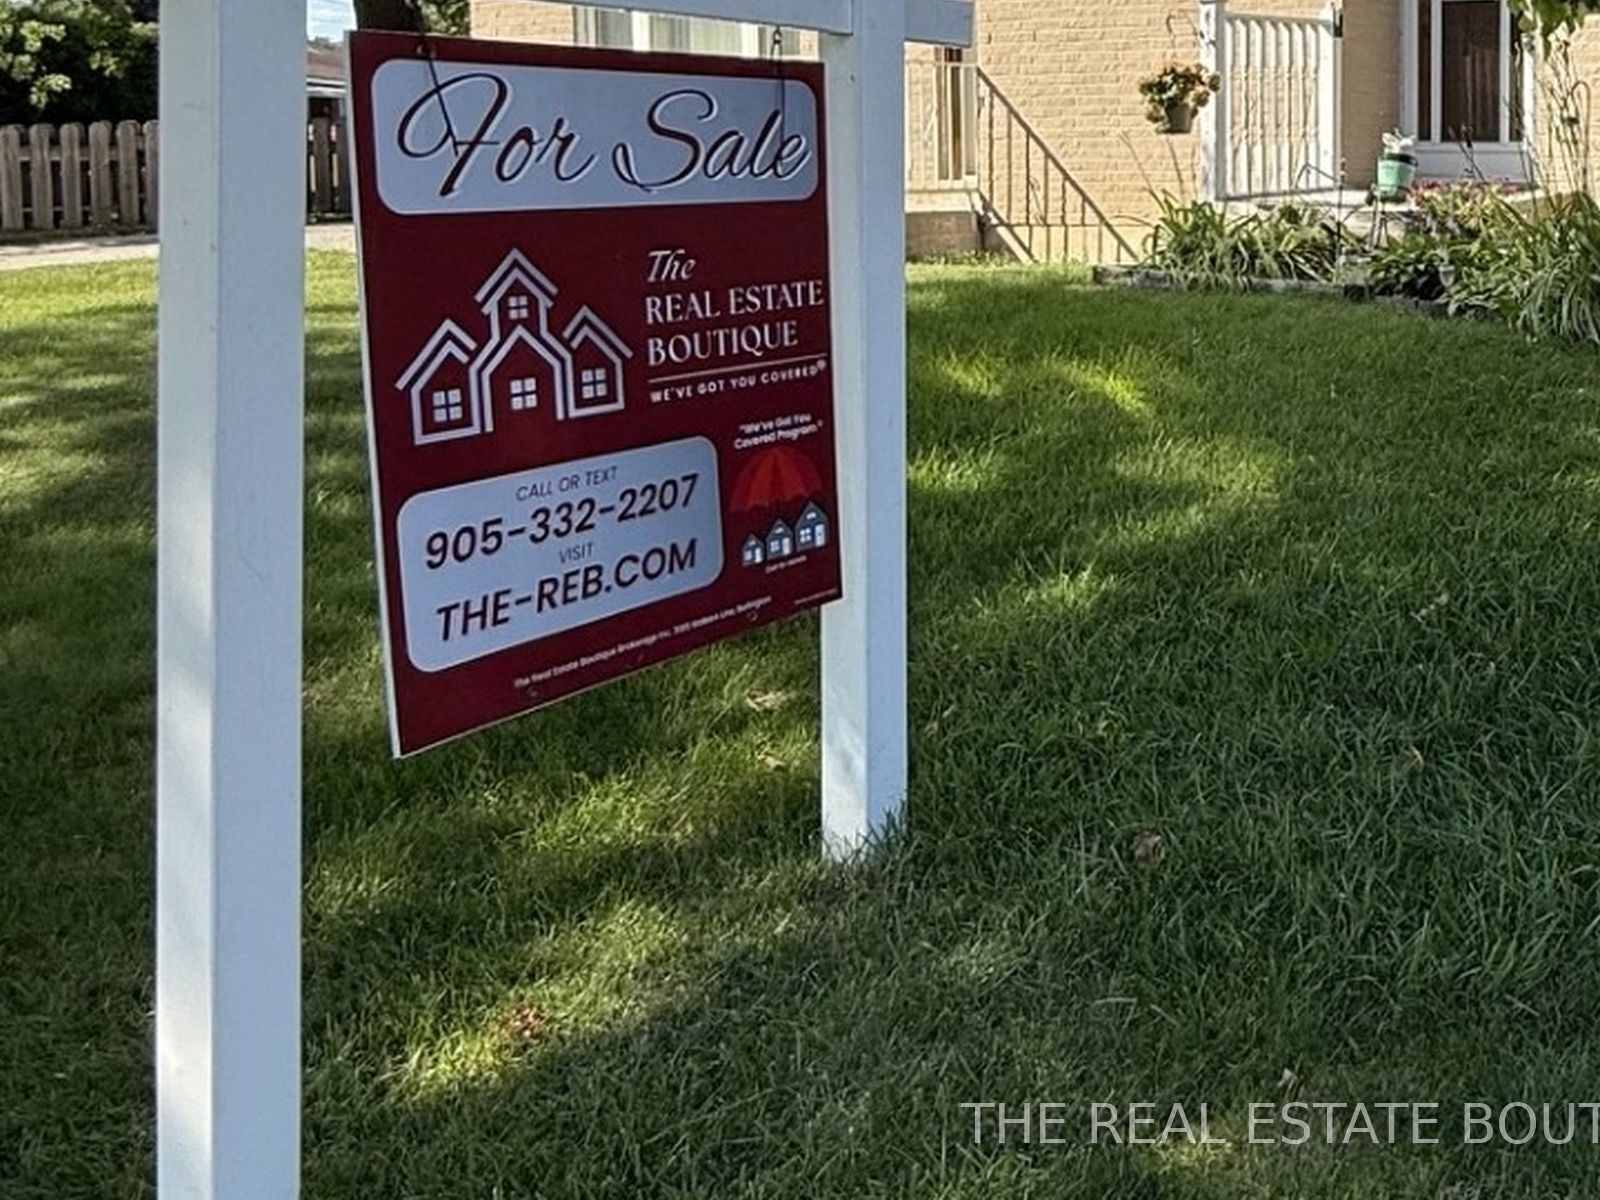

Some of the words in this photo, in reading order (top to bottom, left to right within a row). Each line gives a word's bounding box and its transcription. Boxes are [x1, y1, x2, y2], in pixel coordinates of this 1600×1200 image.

[397, 72, 597, 197] For
[612, 88, 813, 193] Sale
[647, 249, 696, 282] The
[645, 291, 721, 324] REAL
[728, 279, 825, 314] ESTATE
[647, 320, 798, 367] BOUTIQUE
[650, 385, 692, 403] WE'VE
[697, 379, 725, 395] GOT
[729, 374, 757, 391] YOU
[515, 483, 552, 502] CALL
[557, 474, 581, 493] OR
[585, 465, 618, 487] TEXT
[424, 472, 700, 571] 905-332-2207
[558, 541, 594, 565] VISIT
[435, 537, 698, 642] THE-REB.COM
